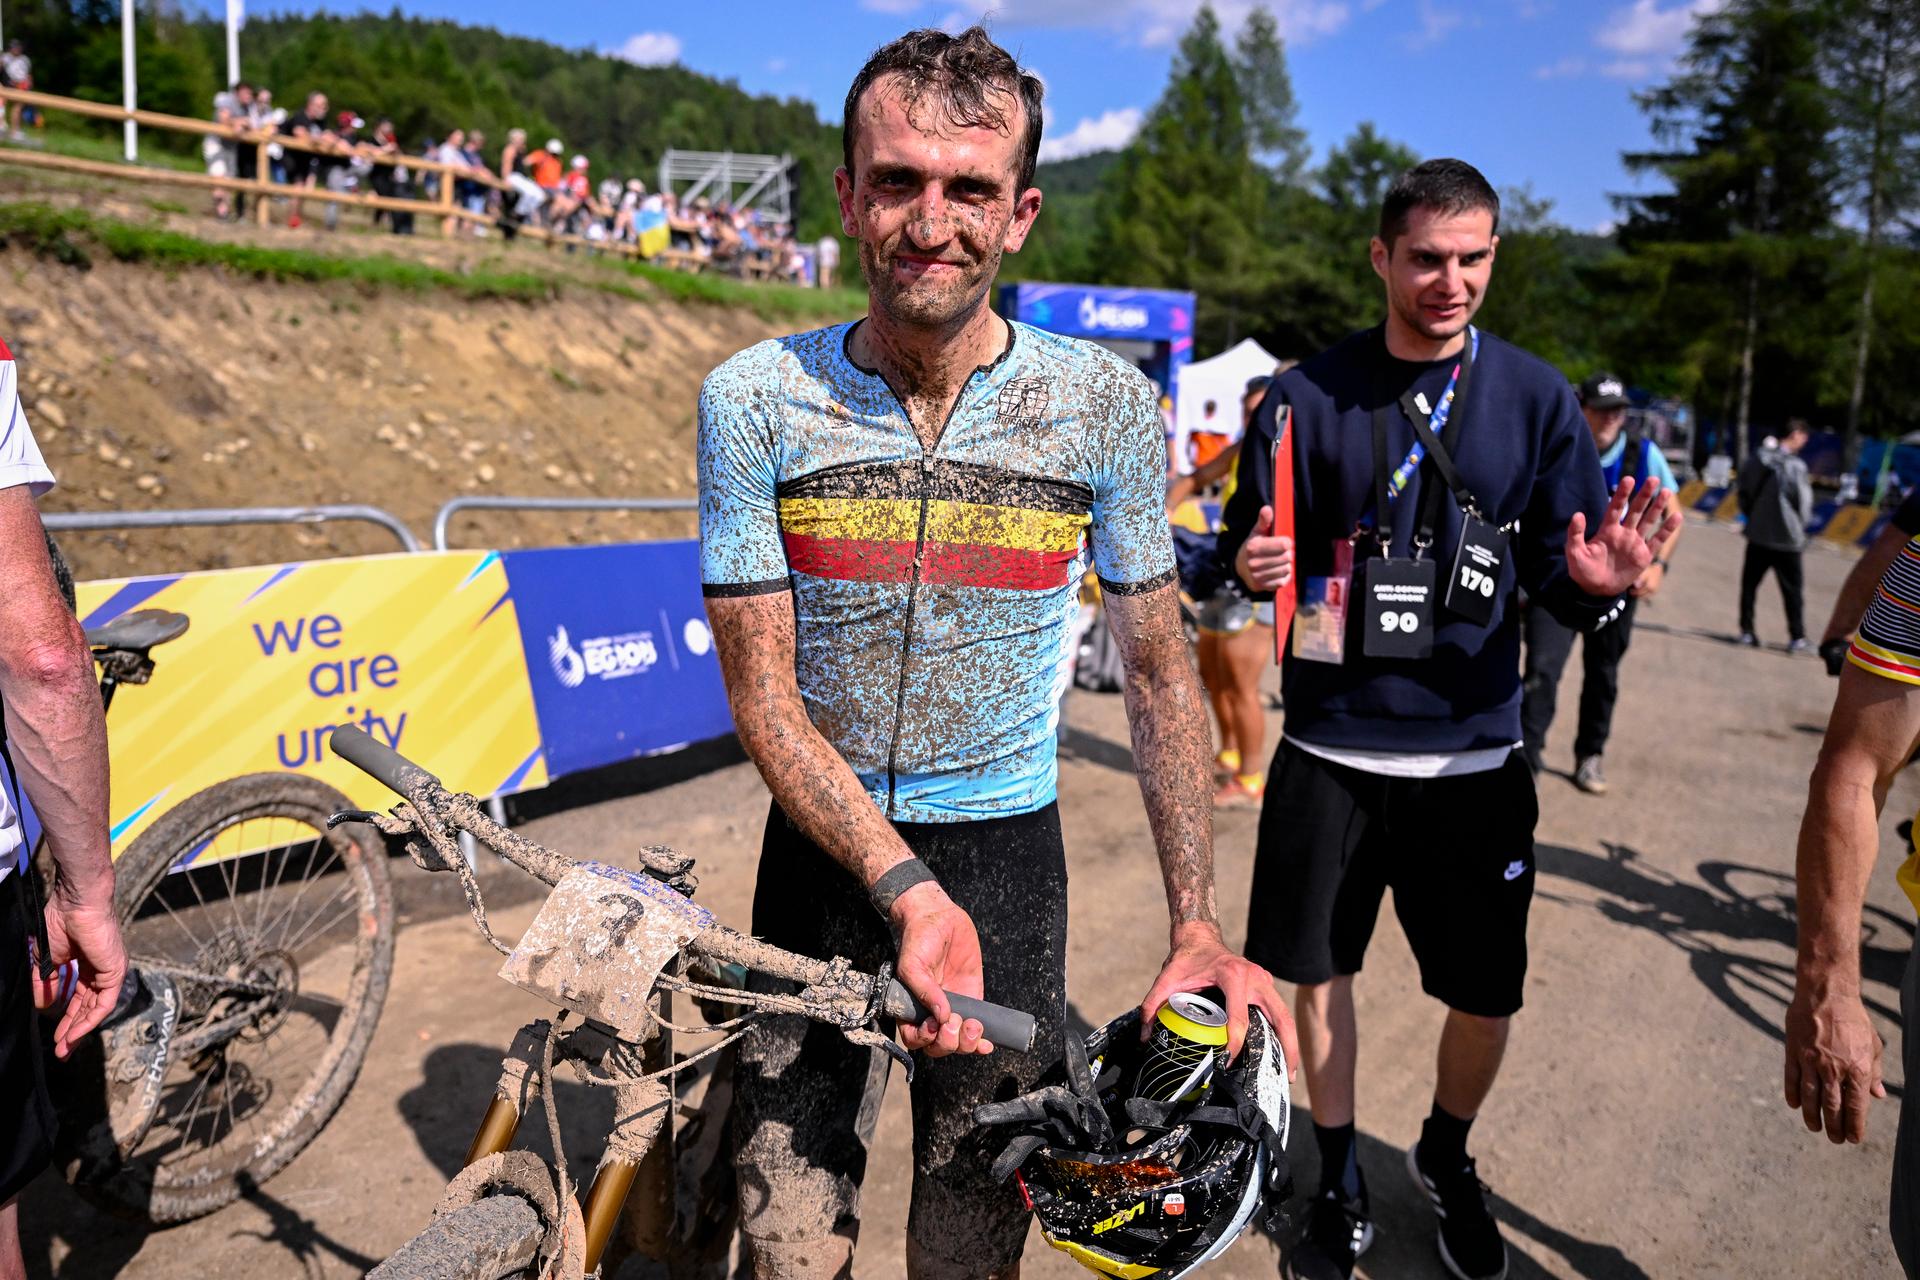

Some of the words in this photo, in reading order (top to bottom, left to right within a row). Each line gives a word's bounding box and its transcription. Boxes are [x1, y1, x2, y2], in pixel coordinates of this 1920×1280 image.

[1460, 565, 1495, 598] 170
[252, 614, 343, 656] we
[1380, 611, 1419, 633] 90
[309, 654, 400, 698] are
[277, 705, 408, 769] unty
[1092, 1200, 1146, 1235] LAZER
